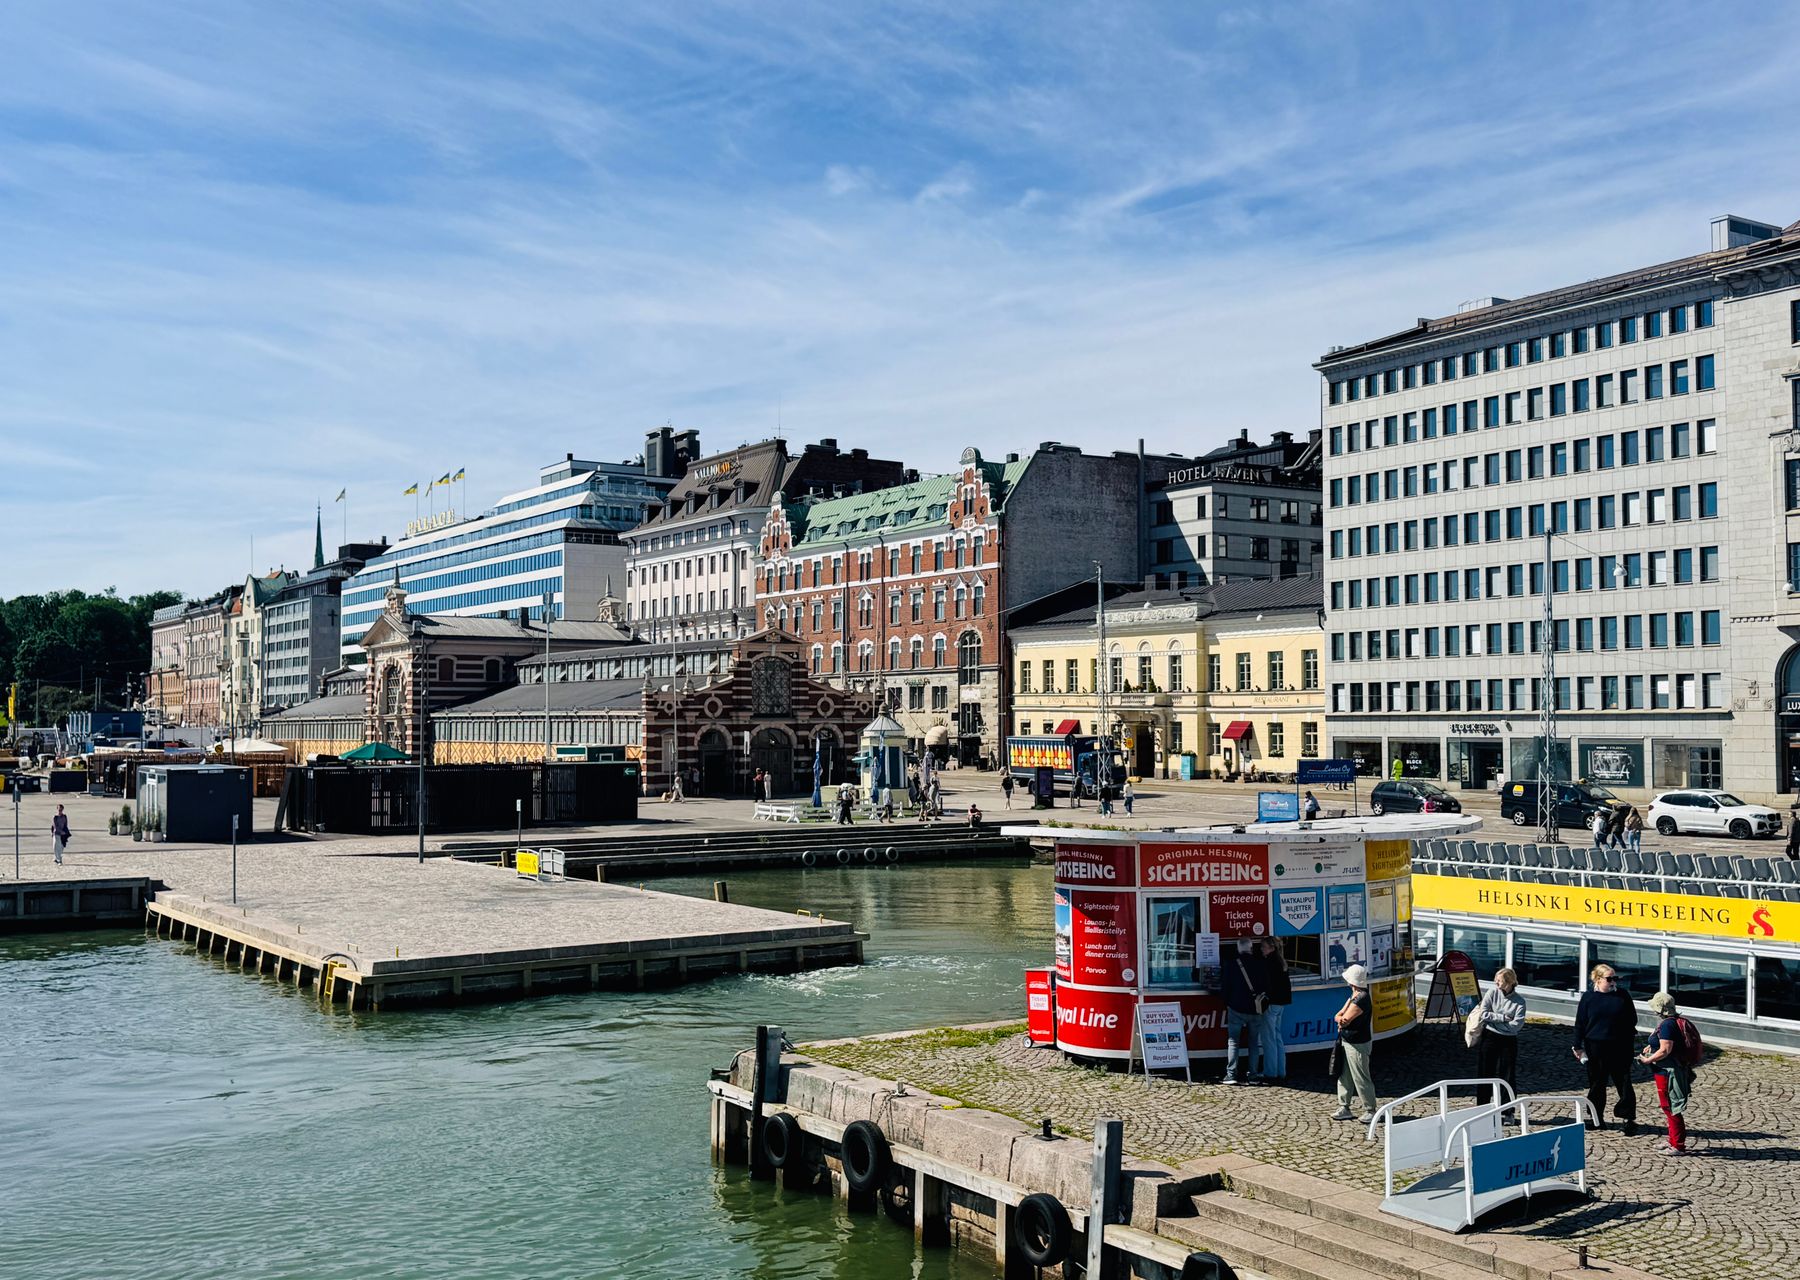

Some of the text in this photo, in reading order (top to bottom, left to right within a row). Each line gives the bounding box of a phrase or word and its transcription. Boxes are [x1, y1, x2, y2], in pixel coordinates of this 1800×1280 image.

[1168, 465, 1207, 484] HOTEL
[407, 508, 455, 534] PALACE
[1071, 851, 1103, 861] HELSINKI
[1157, 848, 1252, 861] ORIGINAL HELSINKI
[1147, 862, 1263, 882] SIGHTSEEING
[1212, 893, 1265, 905] Sightseeing
[1281, 896, 1316, 904] MATKALIPUT
[1084, 903, 1120, 911] Sightseeing
[1285, 904, 1312, 912] BILJETTER
[1478, 889, 1730, 924] HELSINKI SIGHTSEEING
[1225, 911, 1254, 920] Tickets
[1229, 920, 1250, 929] Liput
[1080, 1007, 1118, 1029] Line
[1505, 1157, 1553, 1181] JT-LINE
